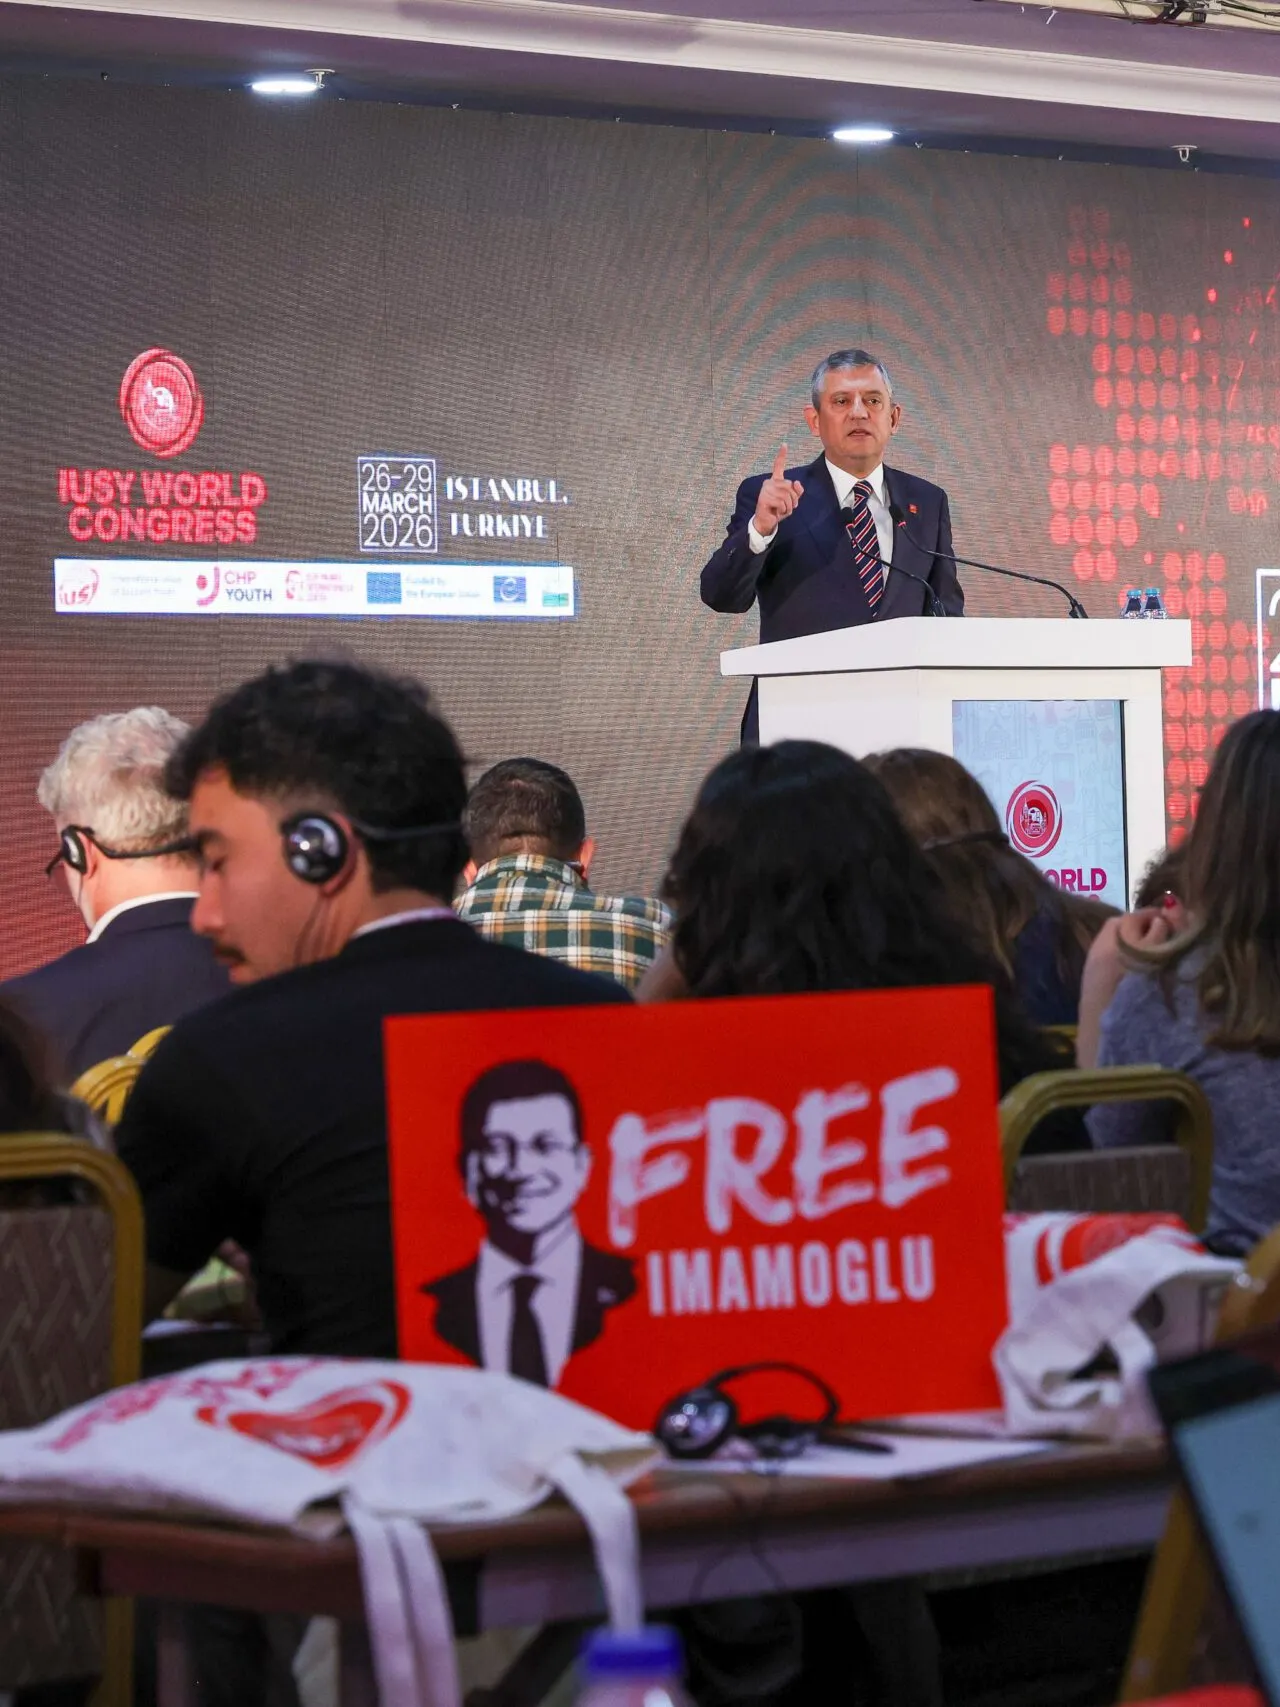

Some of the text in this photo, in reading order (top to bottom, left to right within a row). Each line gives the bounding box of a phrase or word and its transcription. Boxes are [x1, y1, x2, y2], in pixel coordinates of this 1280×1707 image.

[57, 467, 268, 507] IUSY WORLD
[362, 491, 433, 514] MARCH
[446, 477, 568, 504] ISTANBUL,
[68, 505, 257, 544] CONGRESS
[363, 512, 434, 548] 2026
[224, 570, 257, 585] CHP
[225, 588, 273, 602] YOUTH
[1043, 867, 1107, 892] ORLD
[608, 1066, 959, 1248] FREE
[646, 1235, 936, 1316] IMAMOGLU
